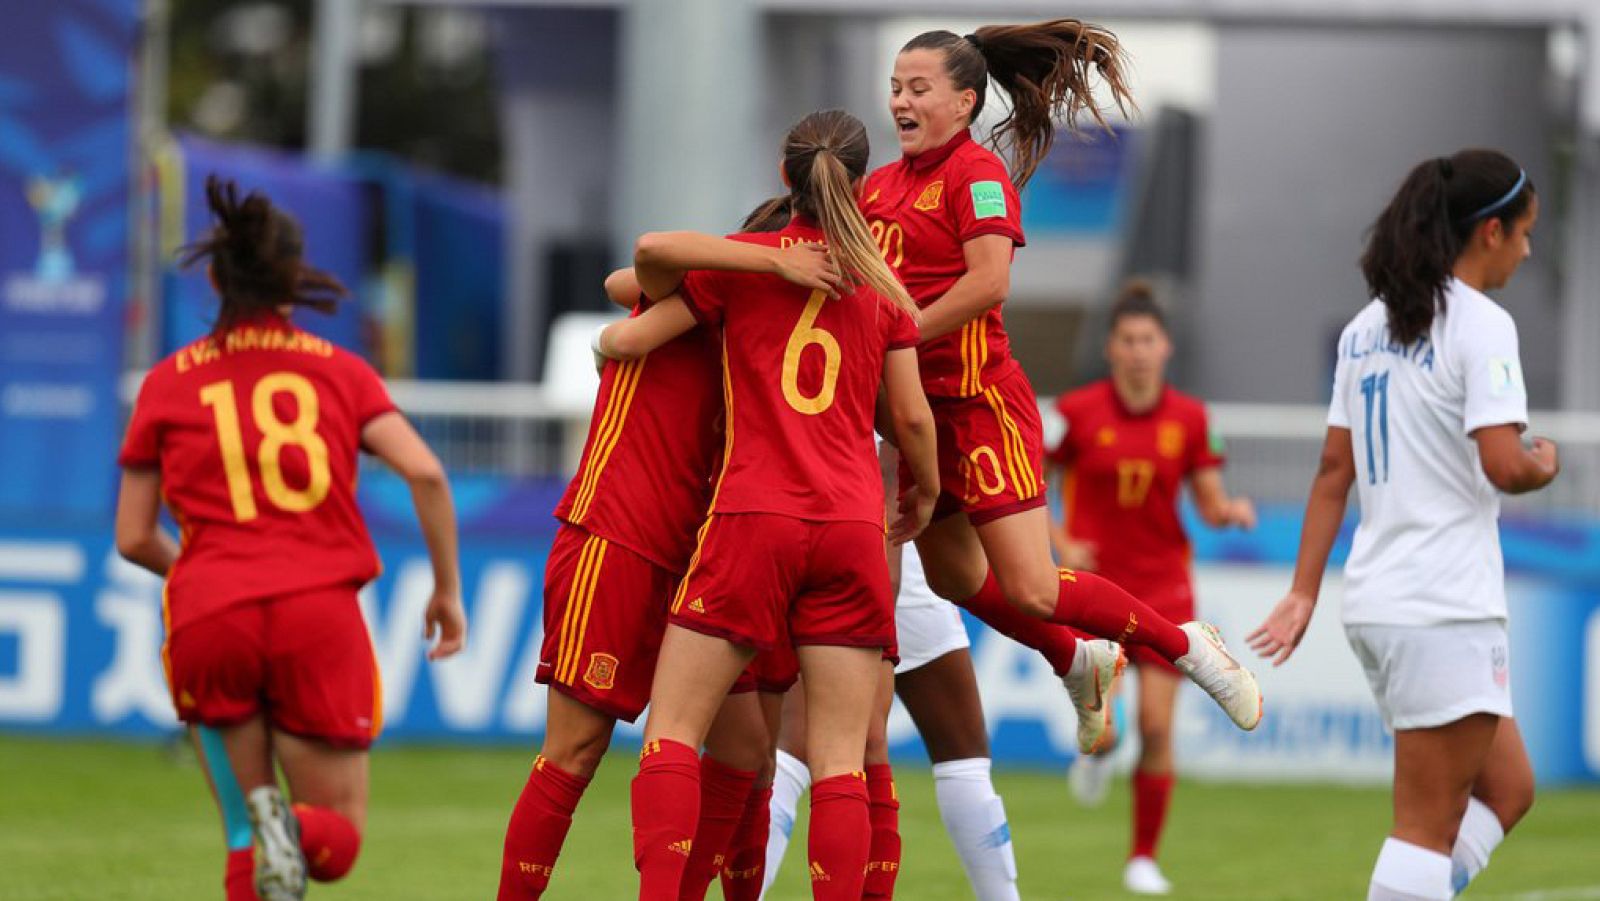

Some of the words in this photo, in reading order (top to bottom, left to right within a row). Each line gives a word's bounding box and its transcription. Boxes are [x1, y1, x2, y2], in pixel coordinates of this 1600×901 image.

[175, 338, 221, 374] EVA
[781, 288, 841, 415] 6
[199, 371, 331, 523] 18
[1116, 459, 1154, 508] 17
[1360, 369, 1389, 485] 11
